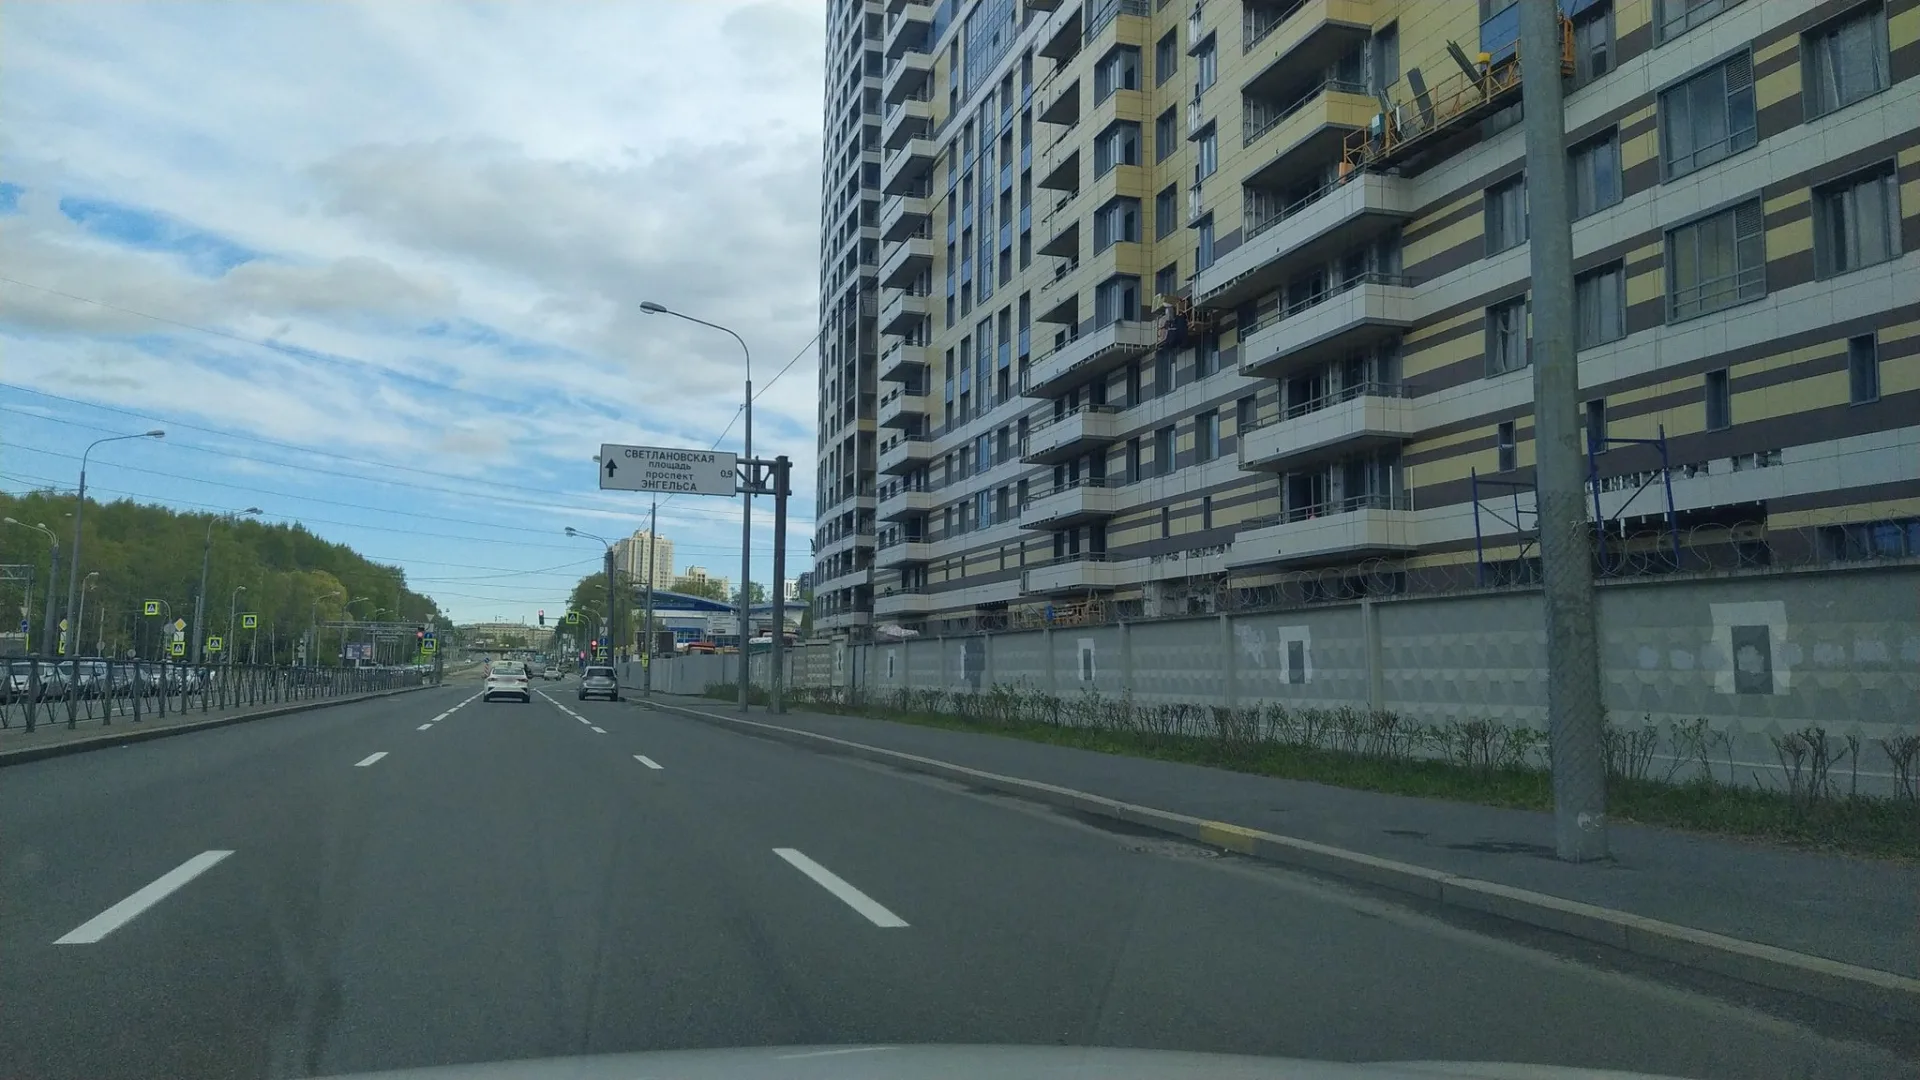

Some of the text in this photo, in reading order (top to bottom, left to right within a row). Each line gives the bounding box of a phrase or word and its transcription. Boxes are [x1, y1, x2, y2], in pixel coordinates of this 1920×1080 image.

[625, 449, 715, 463] СВЕТЛАНОВСКАЯ
[649, 461, 692, 471] площадь
[646, 471, 694, 481] проспект
[641, 480, 697, 491] ЭНГЕЛЬСА
